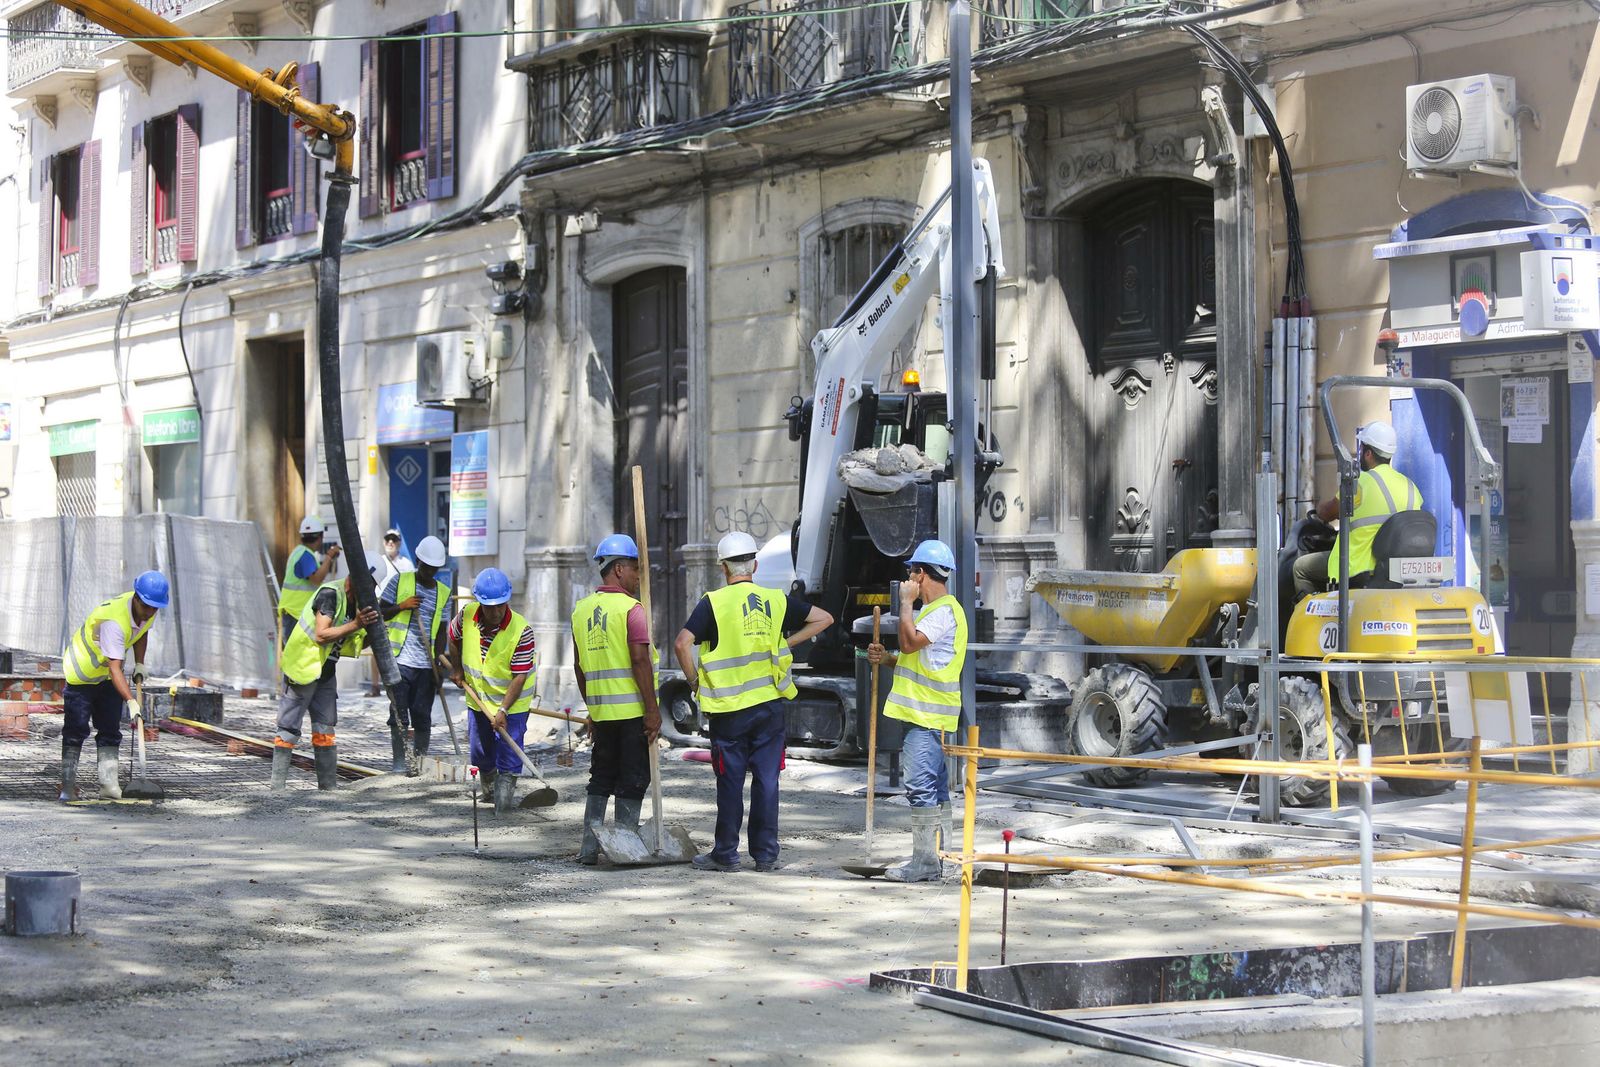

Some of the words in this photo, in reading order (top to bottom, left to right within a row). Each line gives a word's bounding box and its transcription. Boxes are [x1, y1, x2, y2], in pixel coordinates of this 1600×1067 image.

[867, 294, 893, 328] Bobcat
[1098, 590, 1130, 600] WACKER
[1476, 608, 1491, 630] 20
[1323, 627, 1339, 649] 20
